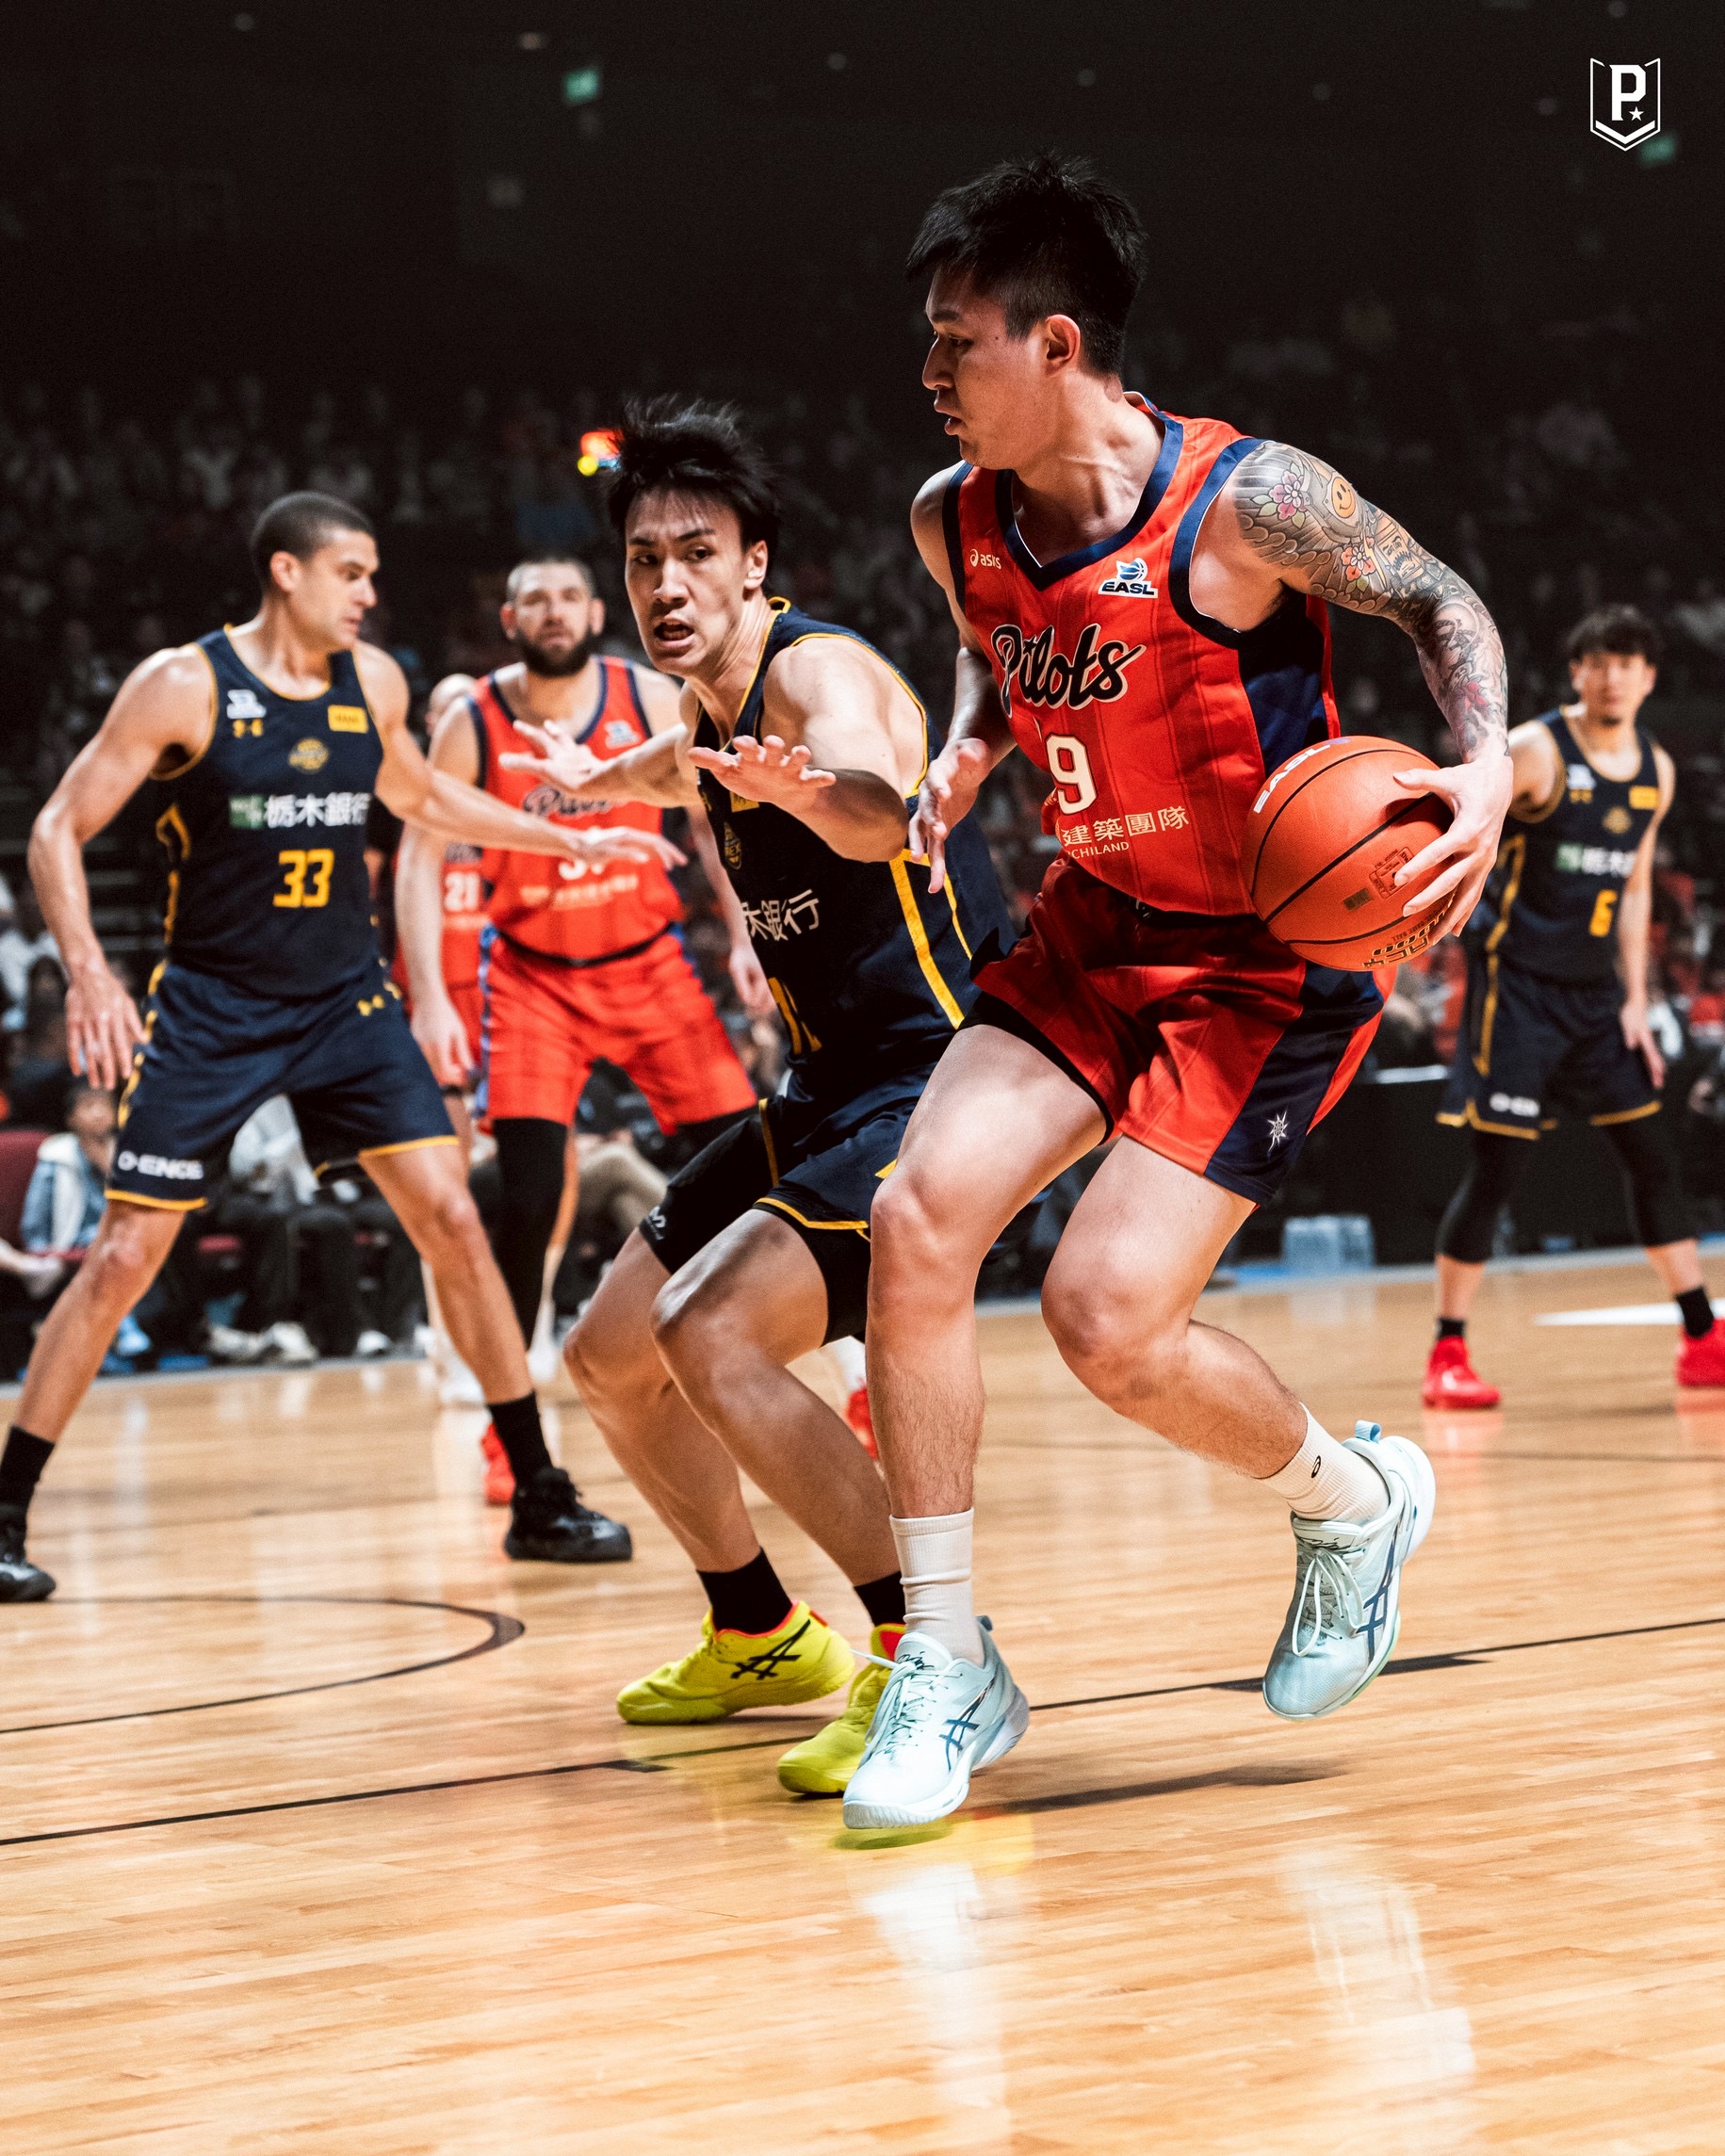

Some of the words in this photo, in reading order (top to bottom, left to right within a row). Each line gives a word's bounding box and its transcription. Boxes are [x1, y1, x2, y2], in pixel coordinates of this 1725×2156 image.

[1101, 581, 1155, 596] EASL
[991, 623, 1147, 719] Pilots
[1033, 718, 1098, 815] 9
[1253, 744, 1331, 814] EASL
[273, 848, 334, 909] 33
[1589, 888, 1619, 938] 6
